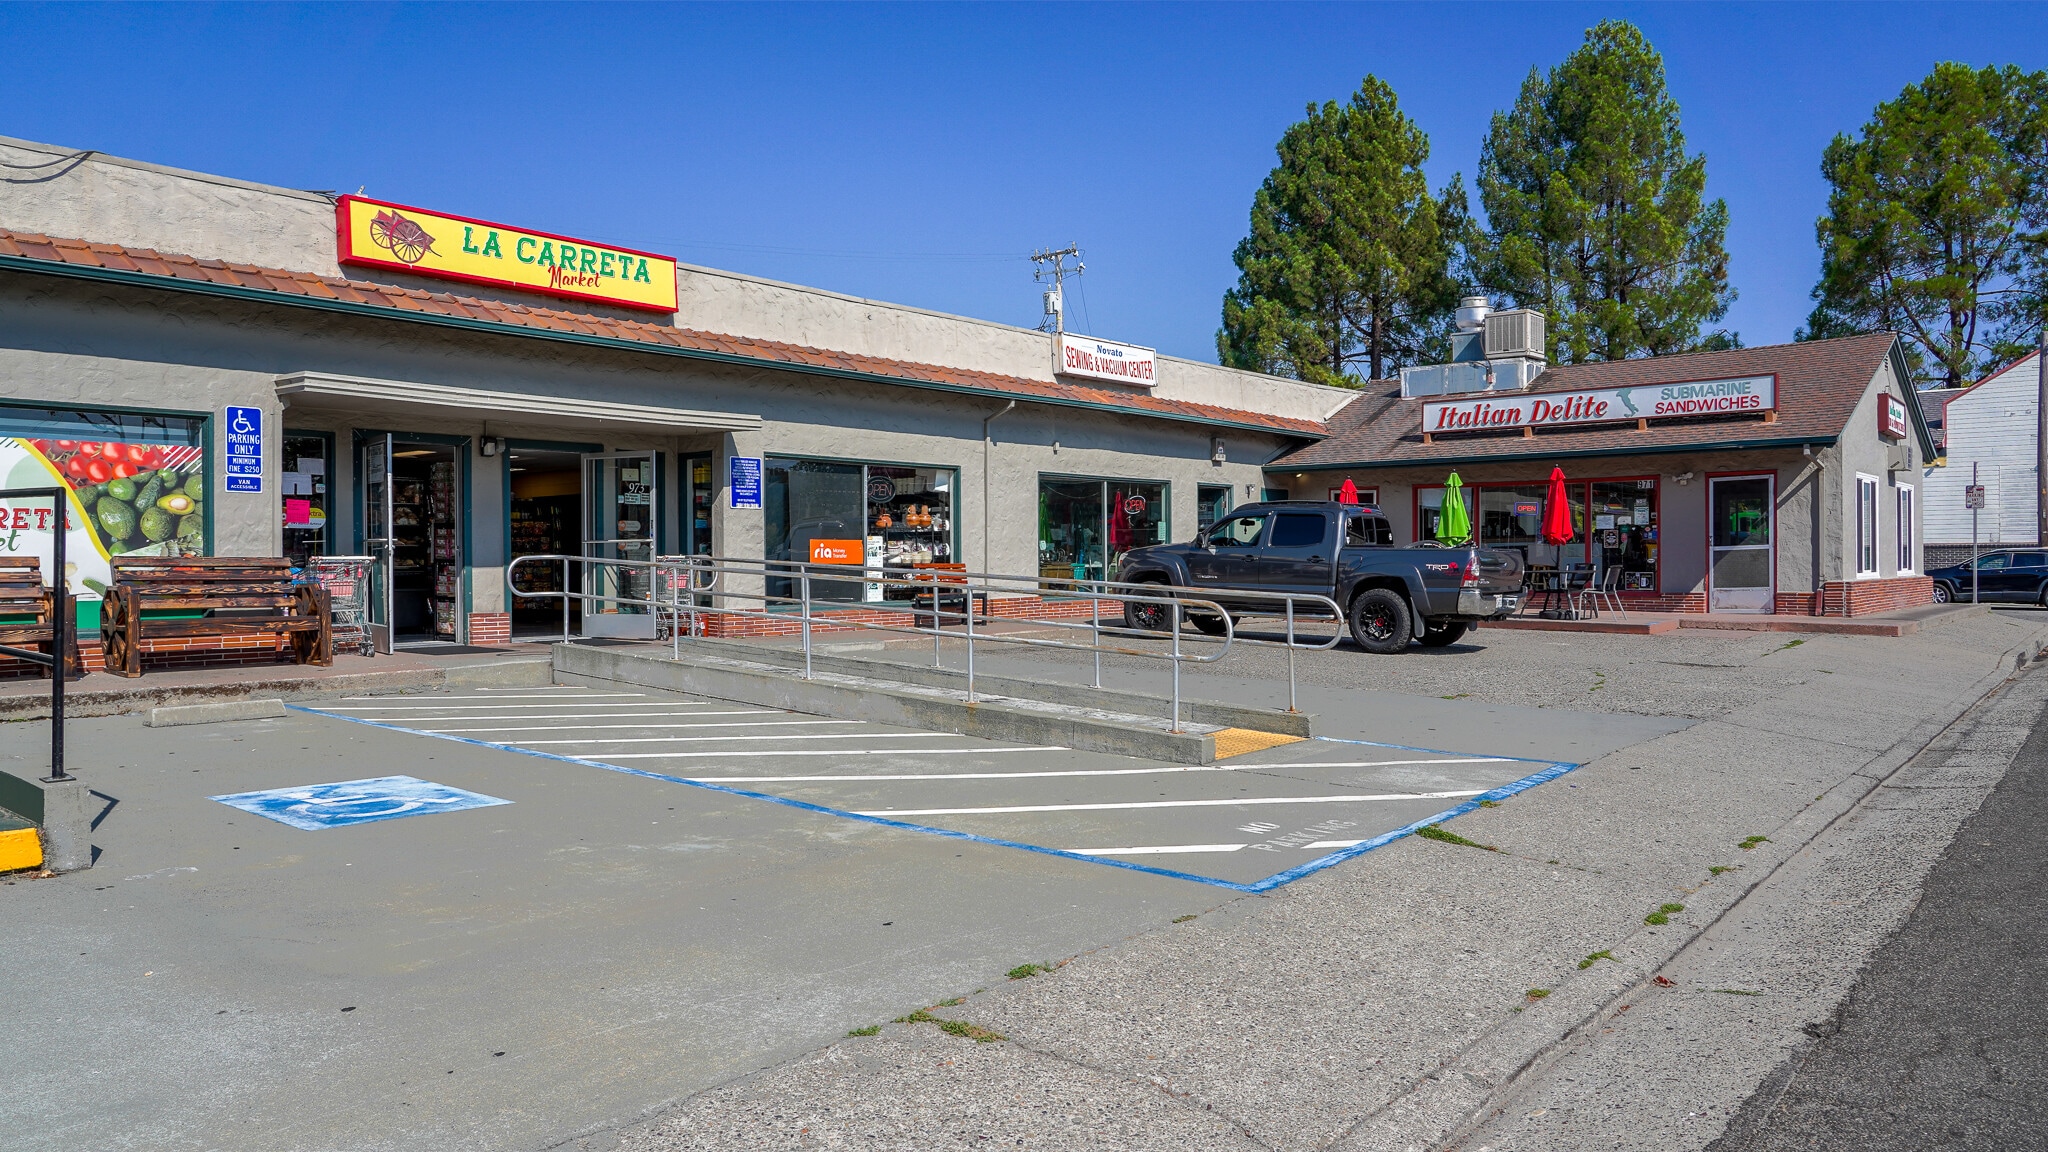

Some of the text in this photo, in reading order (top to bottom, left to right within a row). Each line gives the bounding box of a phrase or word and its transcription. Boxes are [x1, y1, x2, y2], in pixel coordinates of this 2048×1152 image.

[462, 226, 651, 284] LA CARRETA
[548, 265, 601, 289] Market
[1096, 344, 1123, 357] Novato
[1065, 345, 1154, 380] SEWING & VACUUM CENTER
[1660, 381, 1752, 400] SUBMARINE
[1654, 395, 1760, 415] SANDWICHES
[1435, 395, 1608, 430] Italian Delite
[228, 433, 260, 445] PARKING
[234, 444, 254, 455] ONLY
[232, 457, 256, 465] MINIMUM
[228, 465, 241, 473] FINE
[628, 482, 645, 494] 973
[867, 483, 893, 496] OPEN
[1637, 480, 1653, 489] 971
[1125, 499, 1145, 511] OPEN
[814, 543, 832, 559] ria
[1425, 563, 1449, 571] TRD
[1236, 821, 1280, 834] NO
[1247, 819, 1358, 853] PARKING
